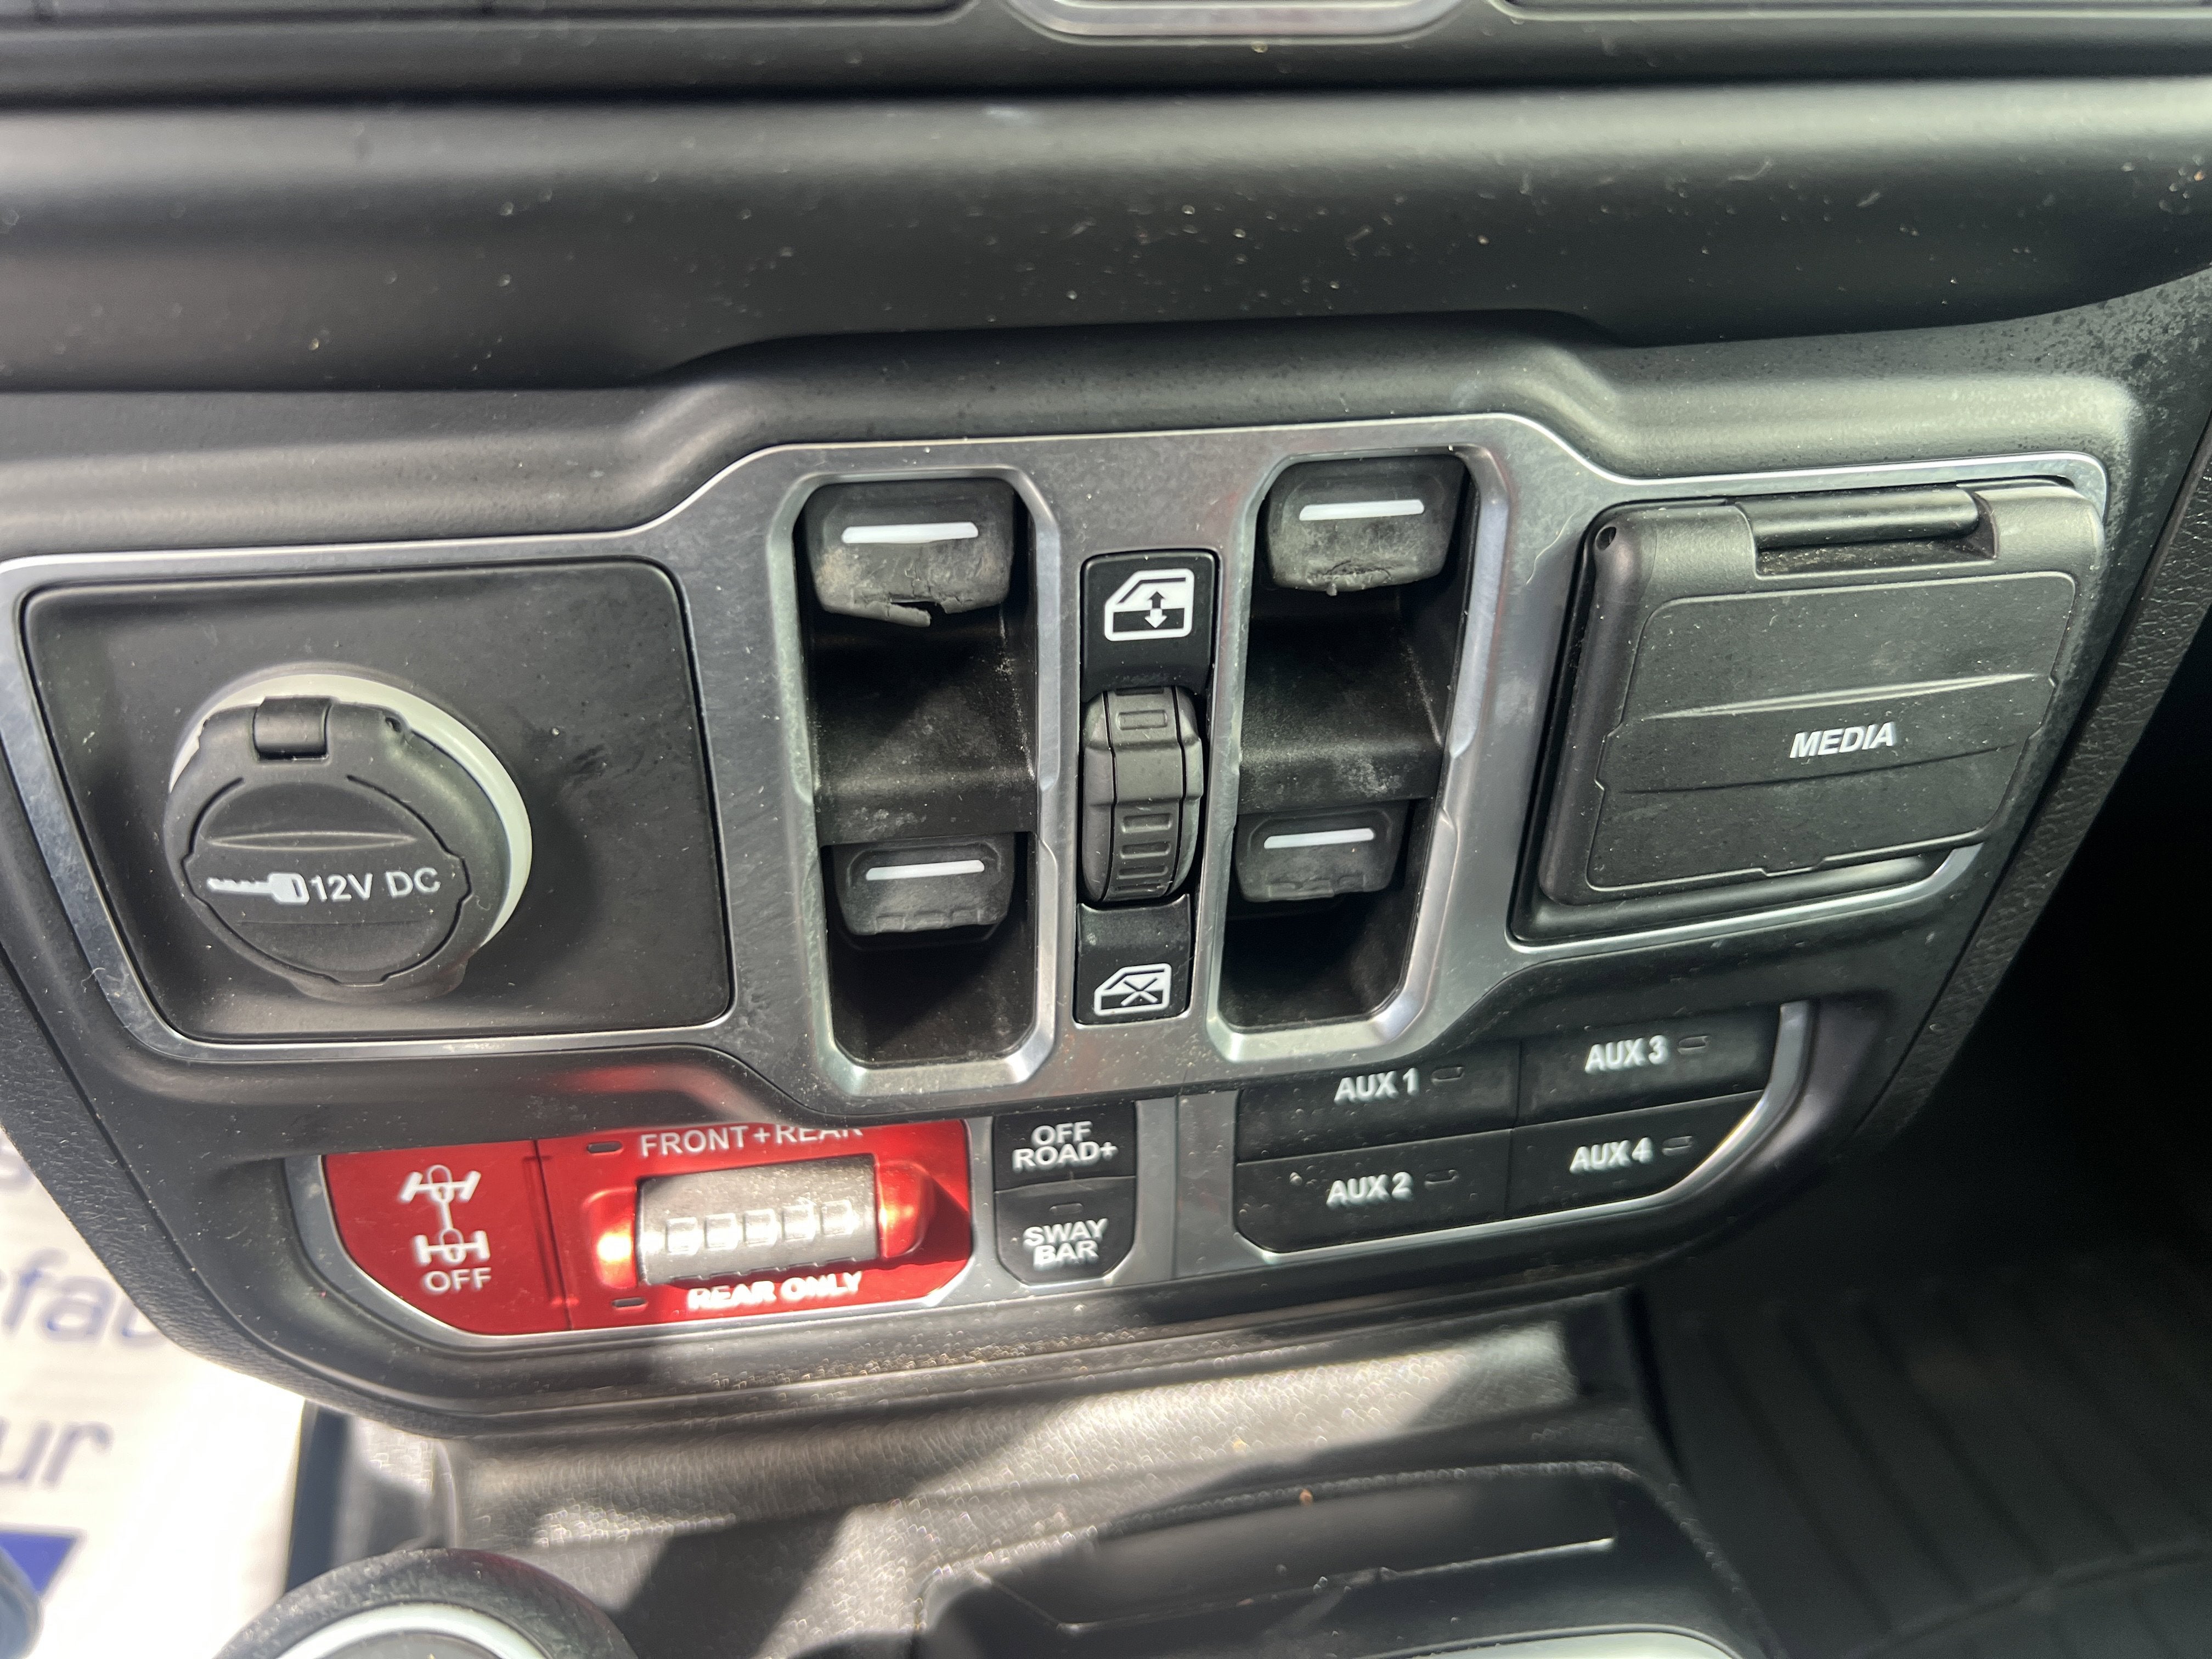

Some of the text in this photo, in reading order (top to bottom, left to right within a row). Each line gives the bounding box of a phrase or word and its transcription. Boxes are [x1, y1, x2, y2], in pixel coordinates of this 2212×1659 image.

[1790, 721, 1896, 758] MEDIA
[310, 867, 441, 901] 12V DC
[1584, 1035, 1668, 1073] AUX 3
[1334, 1067, 1419, 1105] AUX 1
[1031, 1121, 1093, 1148] OFF
[1012, 1141, 1118, 1172] ROAD+
[1326, 1171, 1413, 1208] AUX 2
[1023, 1218, 1109, 1251] SWAY
[1032, 1239, 1098, 1271] BAR
[424, 1267, 492, 1293] OFF
[687, 1271, 862, 1311] REAR ONLY
